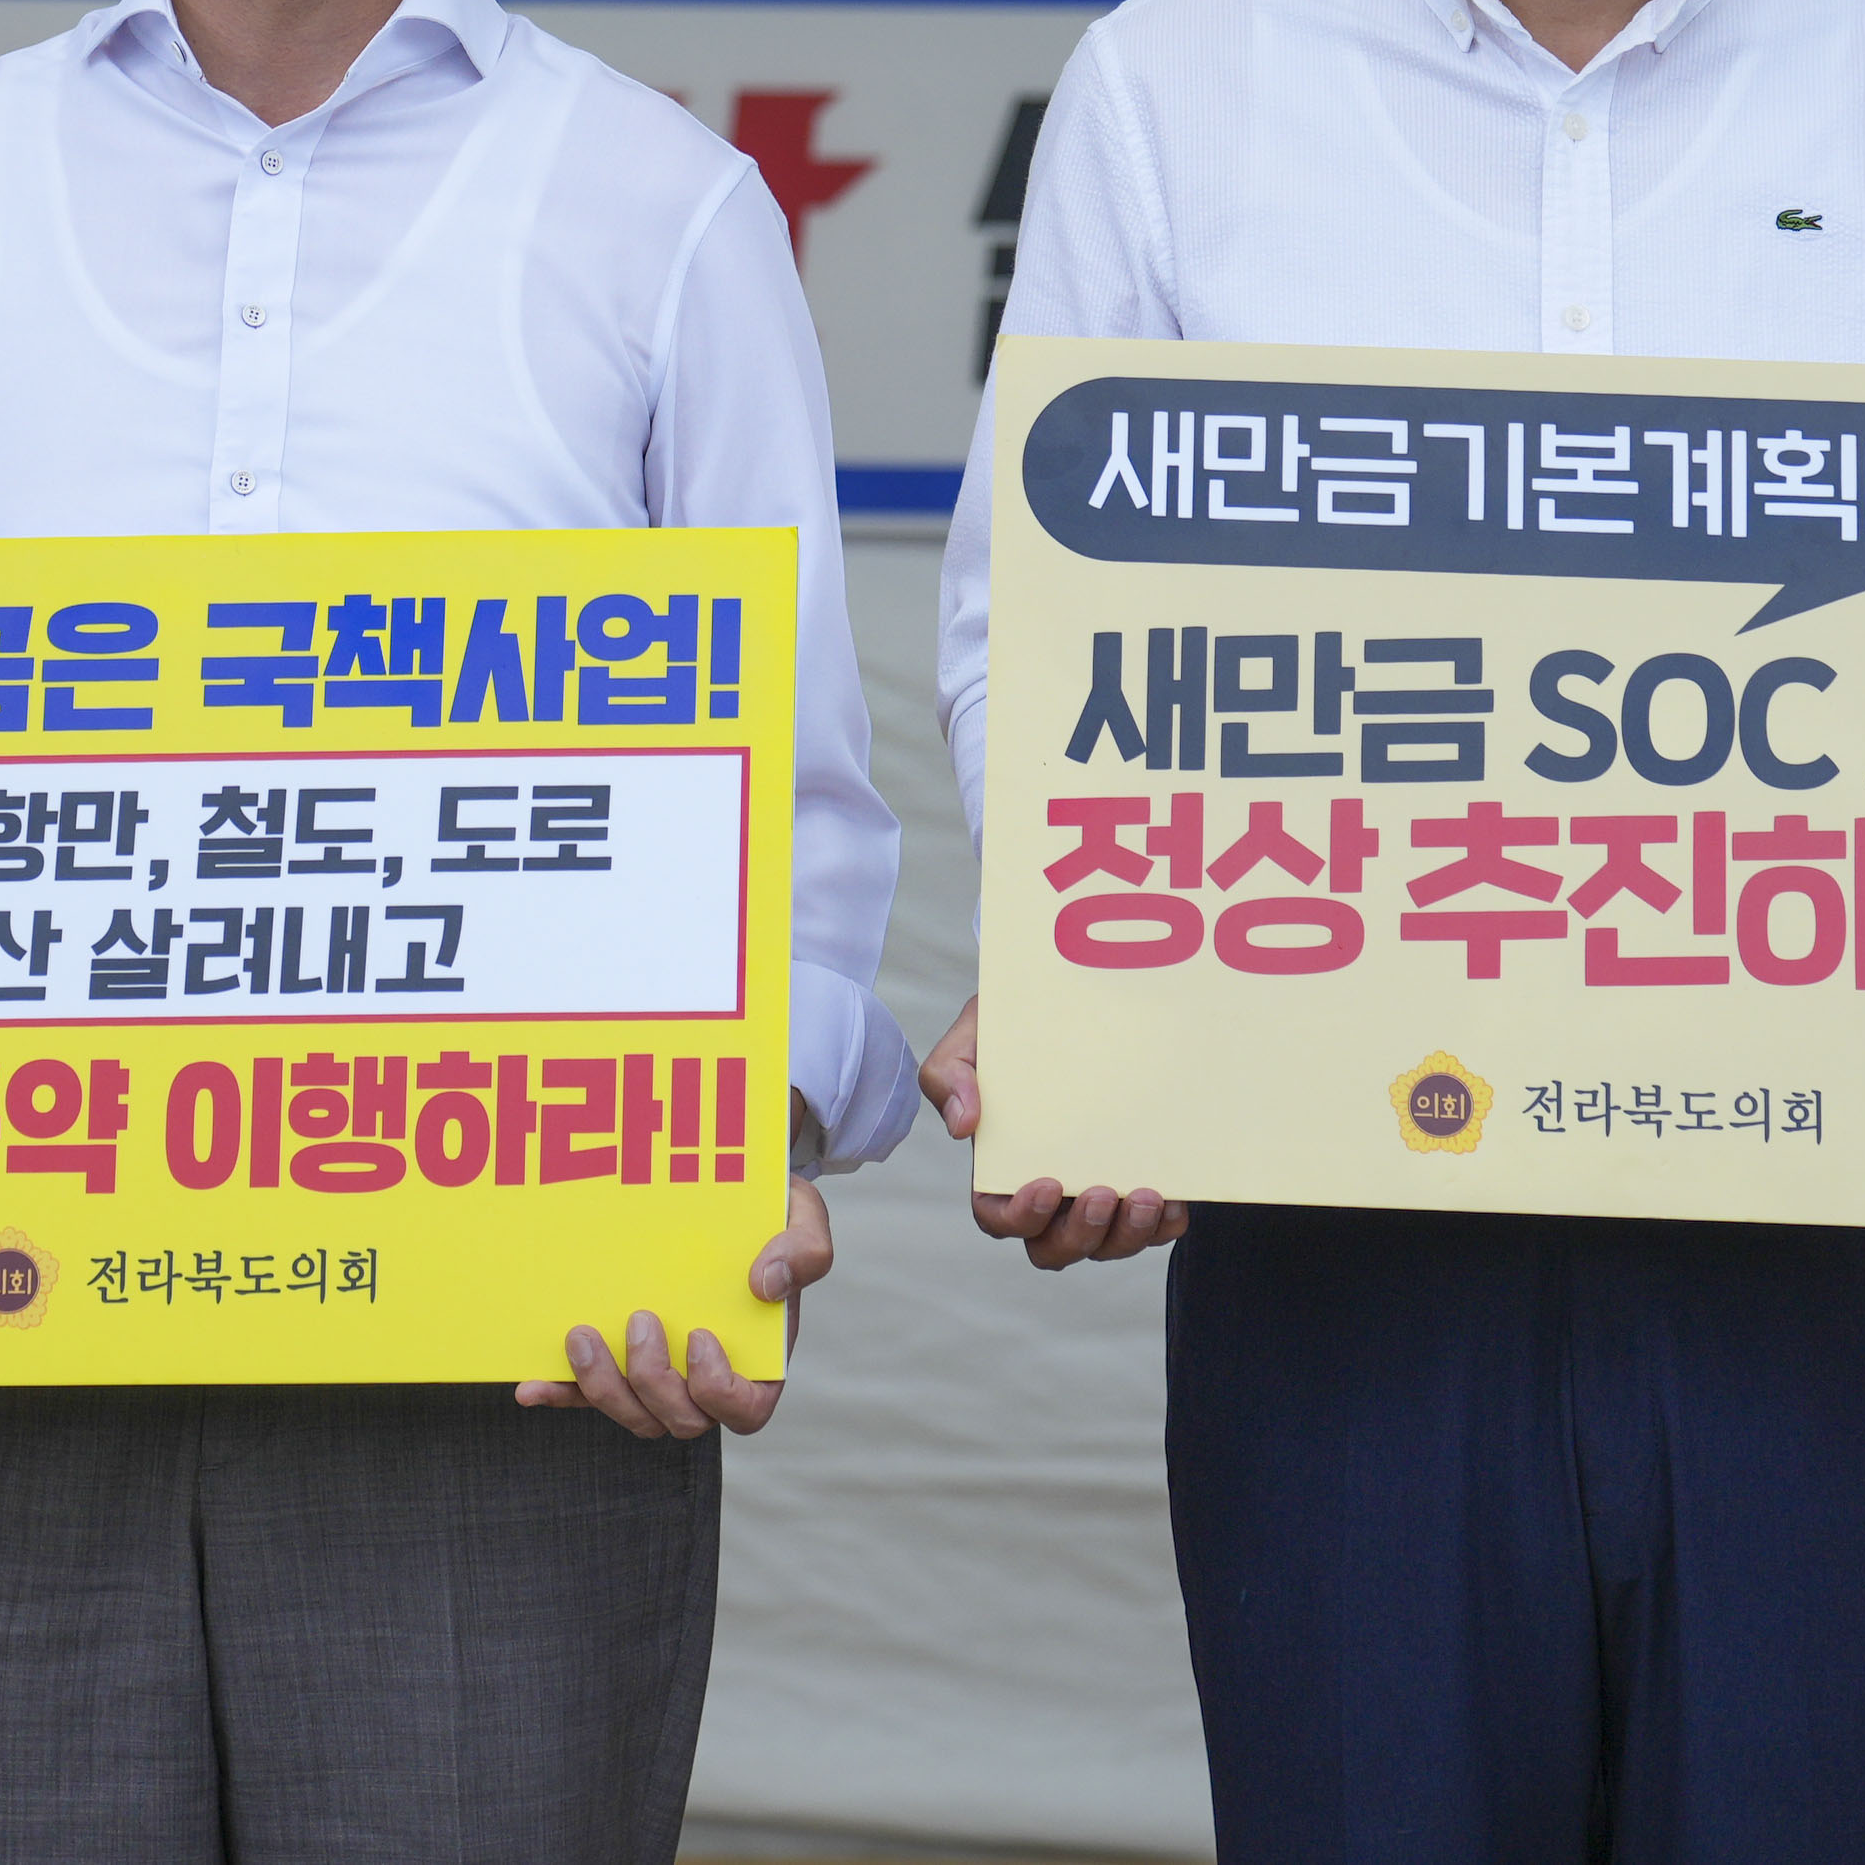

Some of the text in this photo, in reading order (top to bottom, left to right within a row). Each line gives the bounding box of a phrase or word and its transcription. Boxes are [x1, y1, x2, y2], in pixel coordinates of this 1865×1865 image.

[201, 594, 742, 728] 국책사업!
[1065, 626, 1495, 784] 새만금
[1524, 649, 1840, 791] SOC
[197, 786, 404, 889] 철도,
[431, 785, 613, 873] 도로
[1043, 793, 1380, 976] 정상
[89, 905, 465, 1001] 살려내고
[166, 1051, 747, 1194] 이행하라!!
[1412, 1091, 1466, 1121] 의회
[1522, 1080, 1822, 1146] 전라북도의회
[87, 1247, 377, 1305] 전라북도의회
